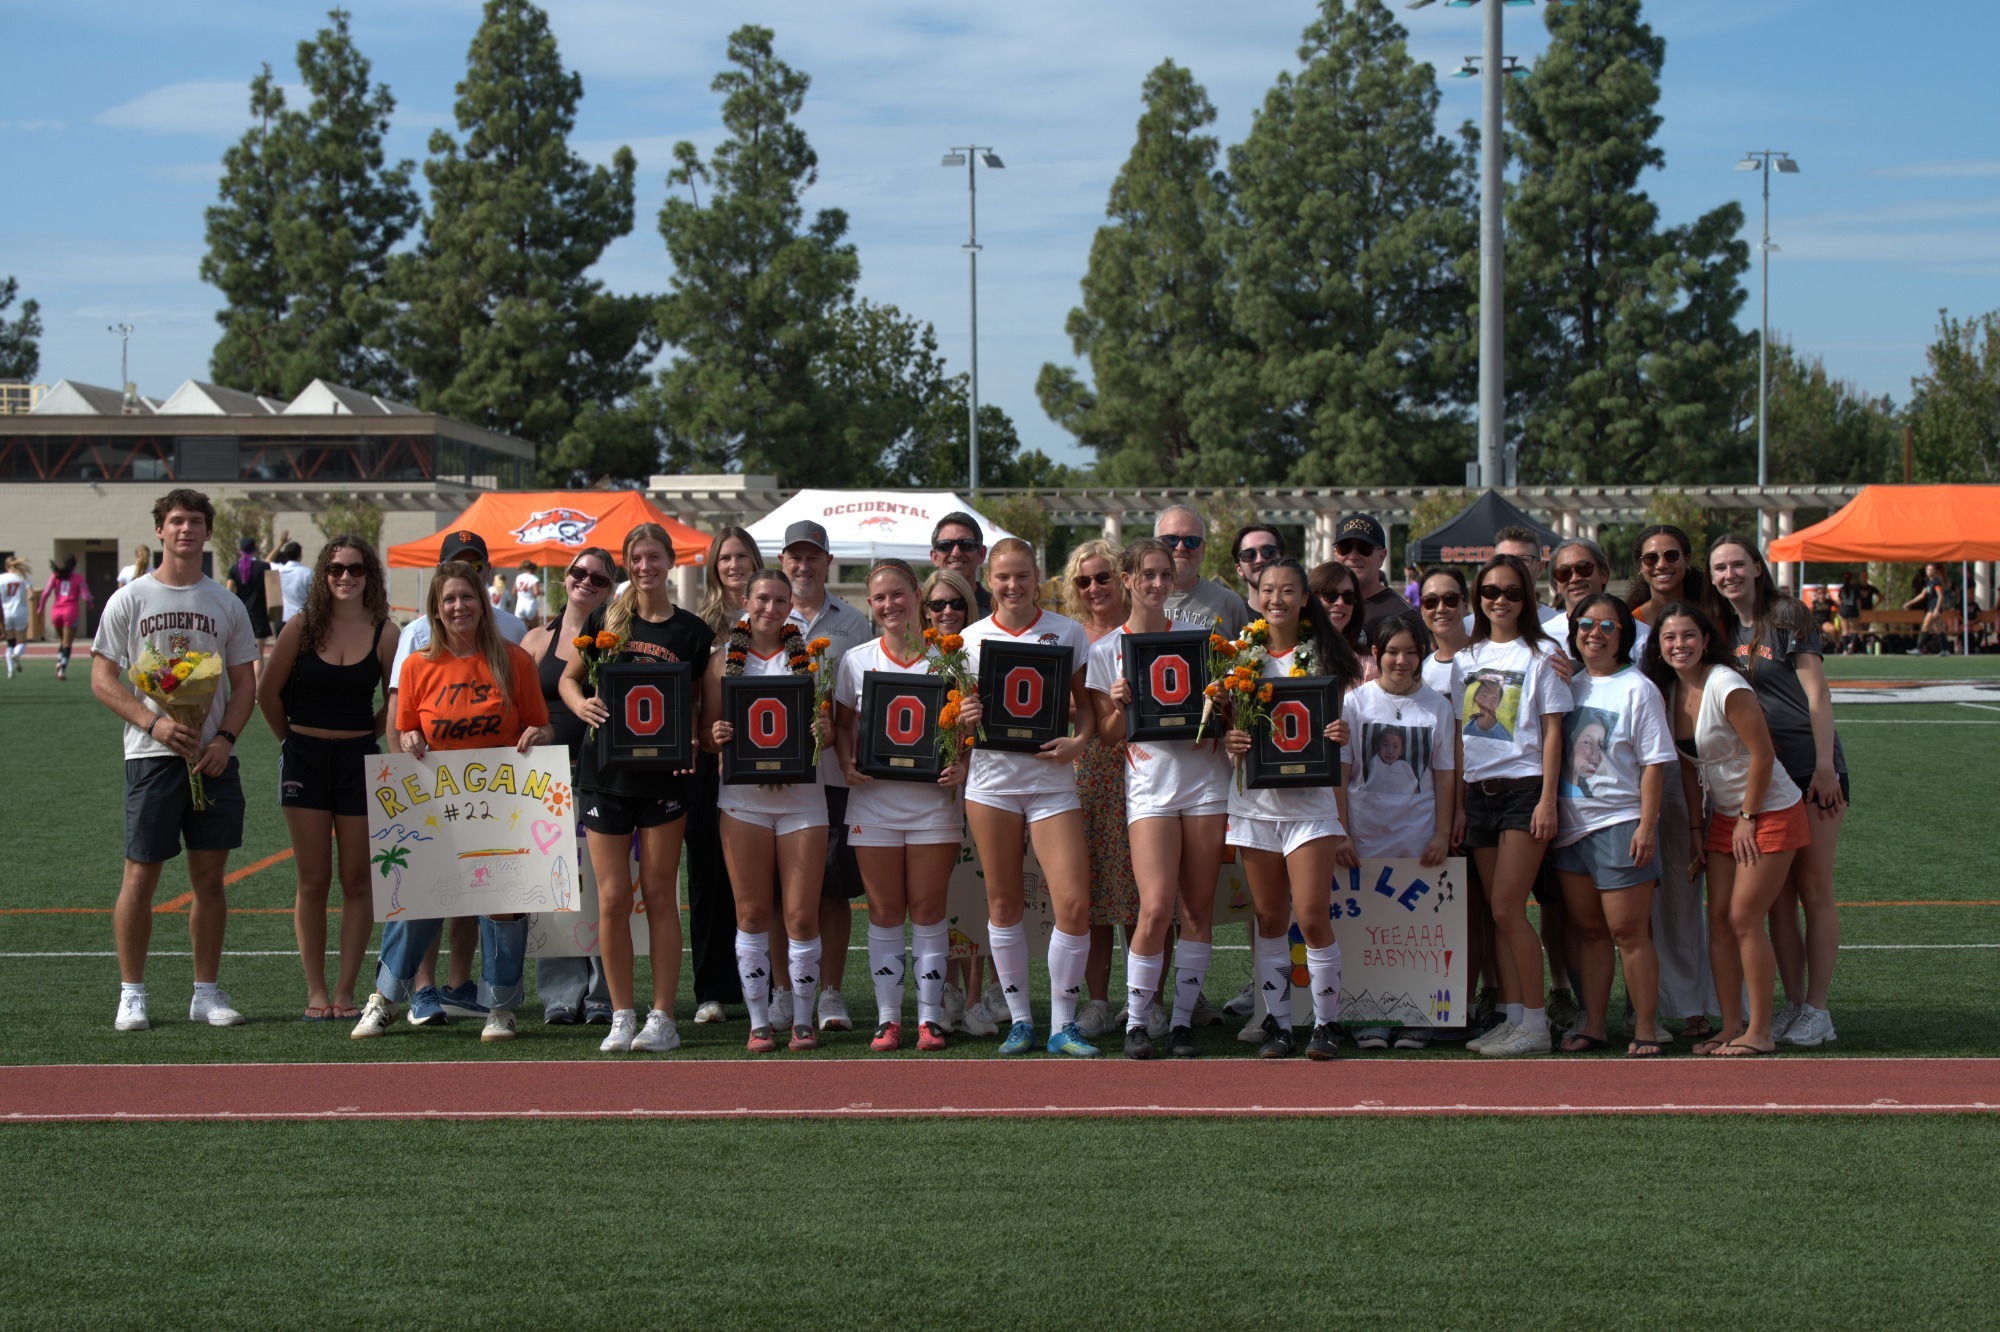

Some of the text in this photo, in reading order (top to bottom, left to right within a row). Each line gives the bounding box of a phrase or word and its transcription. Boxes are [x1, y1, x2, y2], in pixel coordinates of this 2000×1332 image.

[823, 501, 930, 520] OCCIDENTAL
[1441, 546, 1550, 562] OCCIDL
[7, 582, 20, 597] 17
[140, 611, 218, 638] OCCIDENTAL
[1164, 608, 1215, 630] DENTA
[624, 640, 680, 662] CIDENTA
[435, 680, 493, 707] IT'S
[1003, 666, 1044, 718] O
[1150, 654, 1191, 706] O
[625, 684, 665, 736] O
[748, 697, 788, 749] O
[885, 695, 926, 746] O
[430, 714, 502, 740] TIGER
[1270, 700, 1312, 753] O
[375, 762, 552, 820] REAGAN
[444, 800, 494, 822] #22
[1331, 865, 1431, 912] ILE
[1329, 897, 1362, 919] #3
[1366, 925, 1445, 948] YEEAAA
[1363, 949, 1454, 978] BABYYYY!
